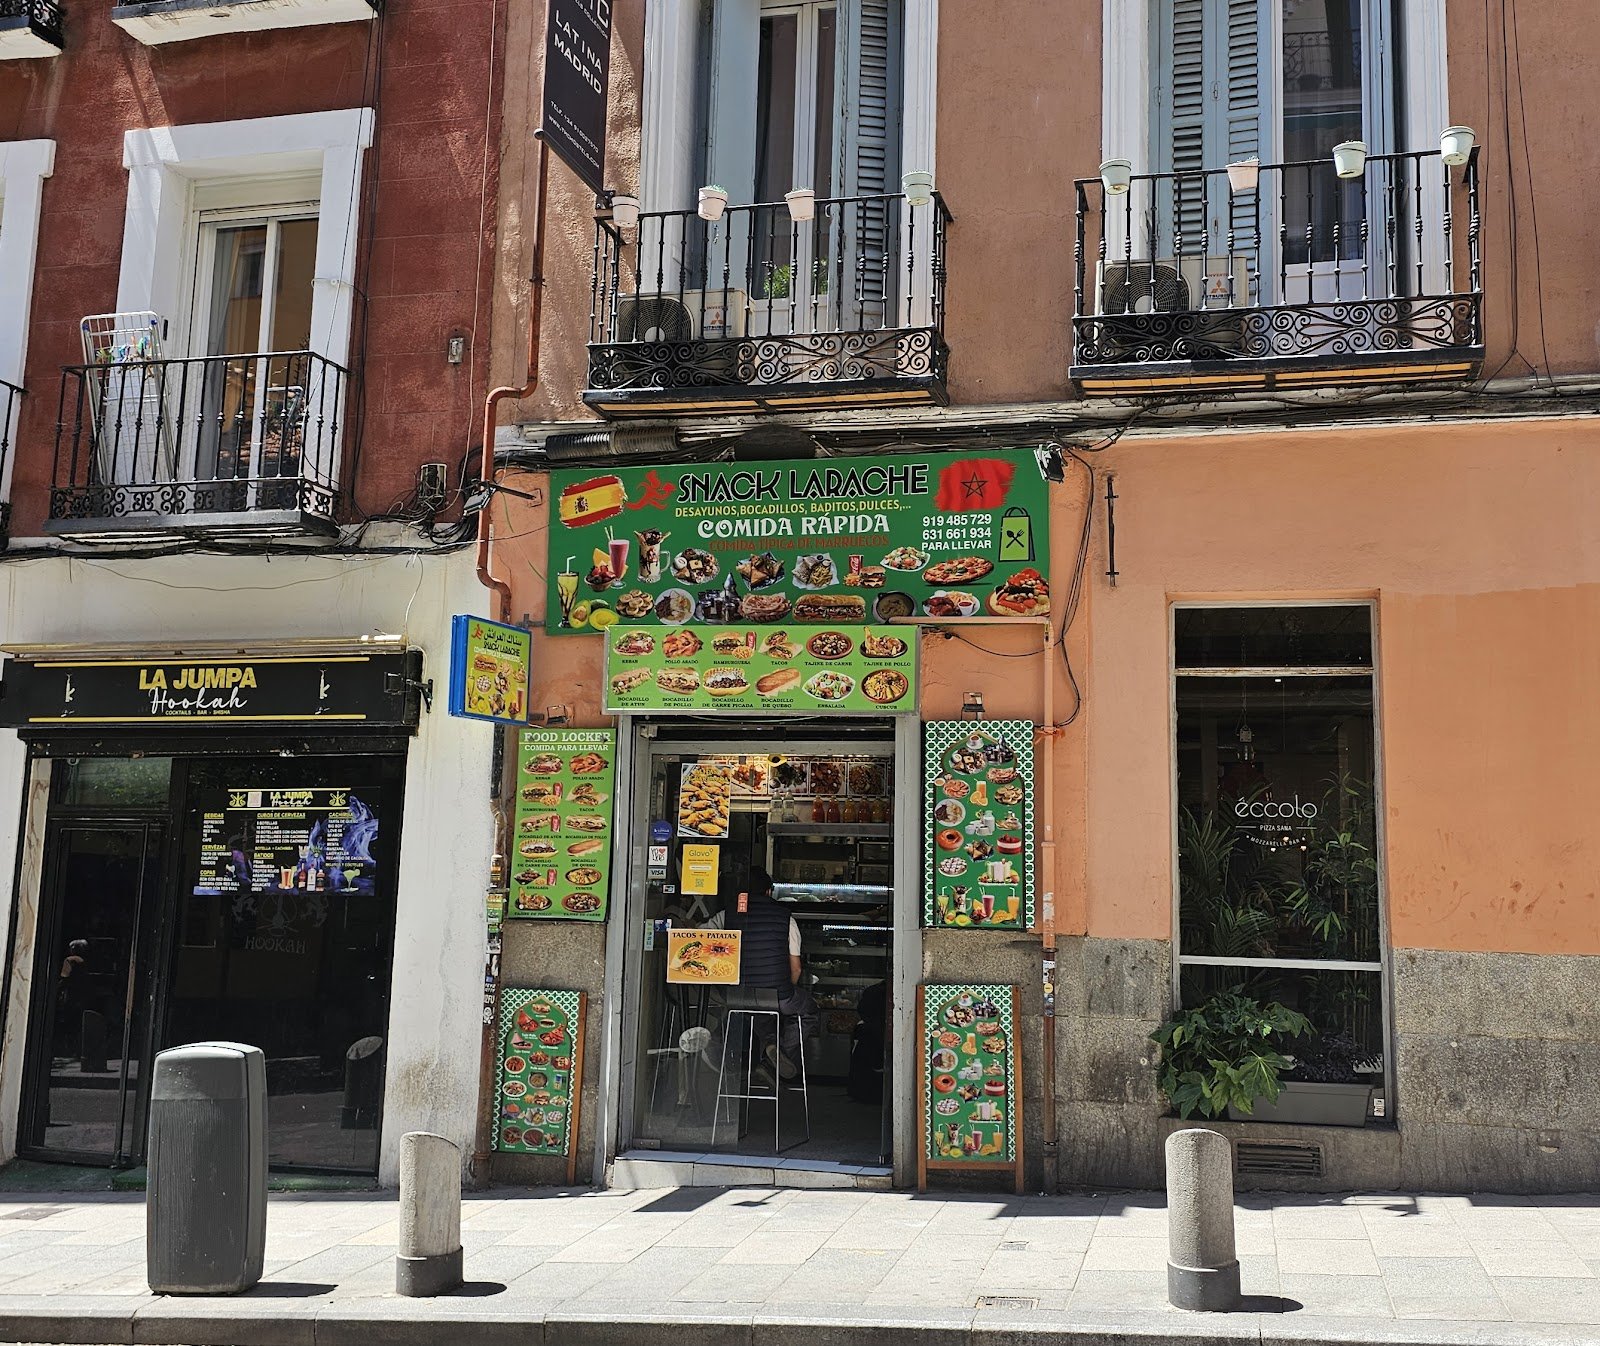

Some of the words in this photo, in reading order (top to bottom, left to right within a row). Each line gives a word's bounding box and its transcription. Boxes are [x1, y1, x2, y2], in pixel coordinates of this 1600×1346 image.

[556, 10, 603, 74] LATINA
[554, 33, 602, 94] MADRID
[678, 470, 781, 503] SNACK
[790, 464, 929, 500] LARACHE
[698, 518, 794, 539] COMIDA
[801, 514, 890, 536] RÁPIDA
[923, 516, 944, 527] 919
[946, 515, 968, 526] 485
[970, 514, 992, 525] 729
[797, 538, 810, 549] DE
[815, 535, 890, 548] MARRUECOS
[923, 529, 942, 540] 631
[946, 528, 966, 539] 661
[970, 528, 992, 538] 934
[922, 542, 950, 550] PARA
[952, 540, 992, 550] LLEVAR
[139, 669, 167, 690] LA
[173, 667, 257, 689] JUMPA
[149, 687, 248, 715] Hookah
[524, 732, 558, 742] FOOD
[270, 792, 281, 800] LA
[282, 791, 314, 799] JUMPA
